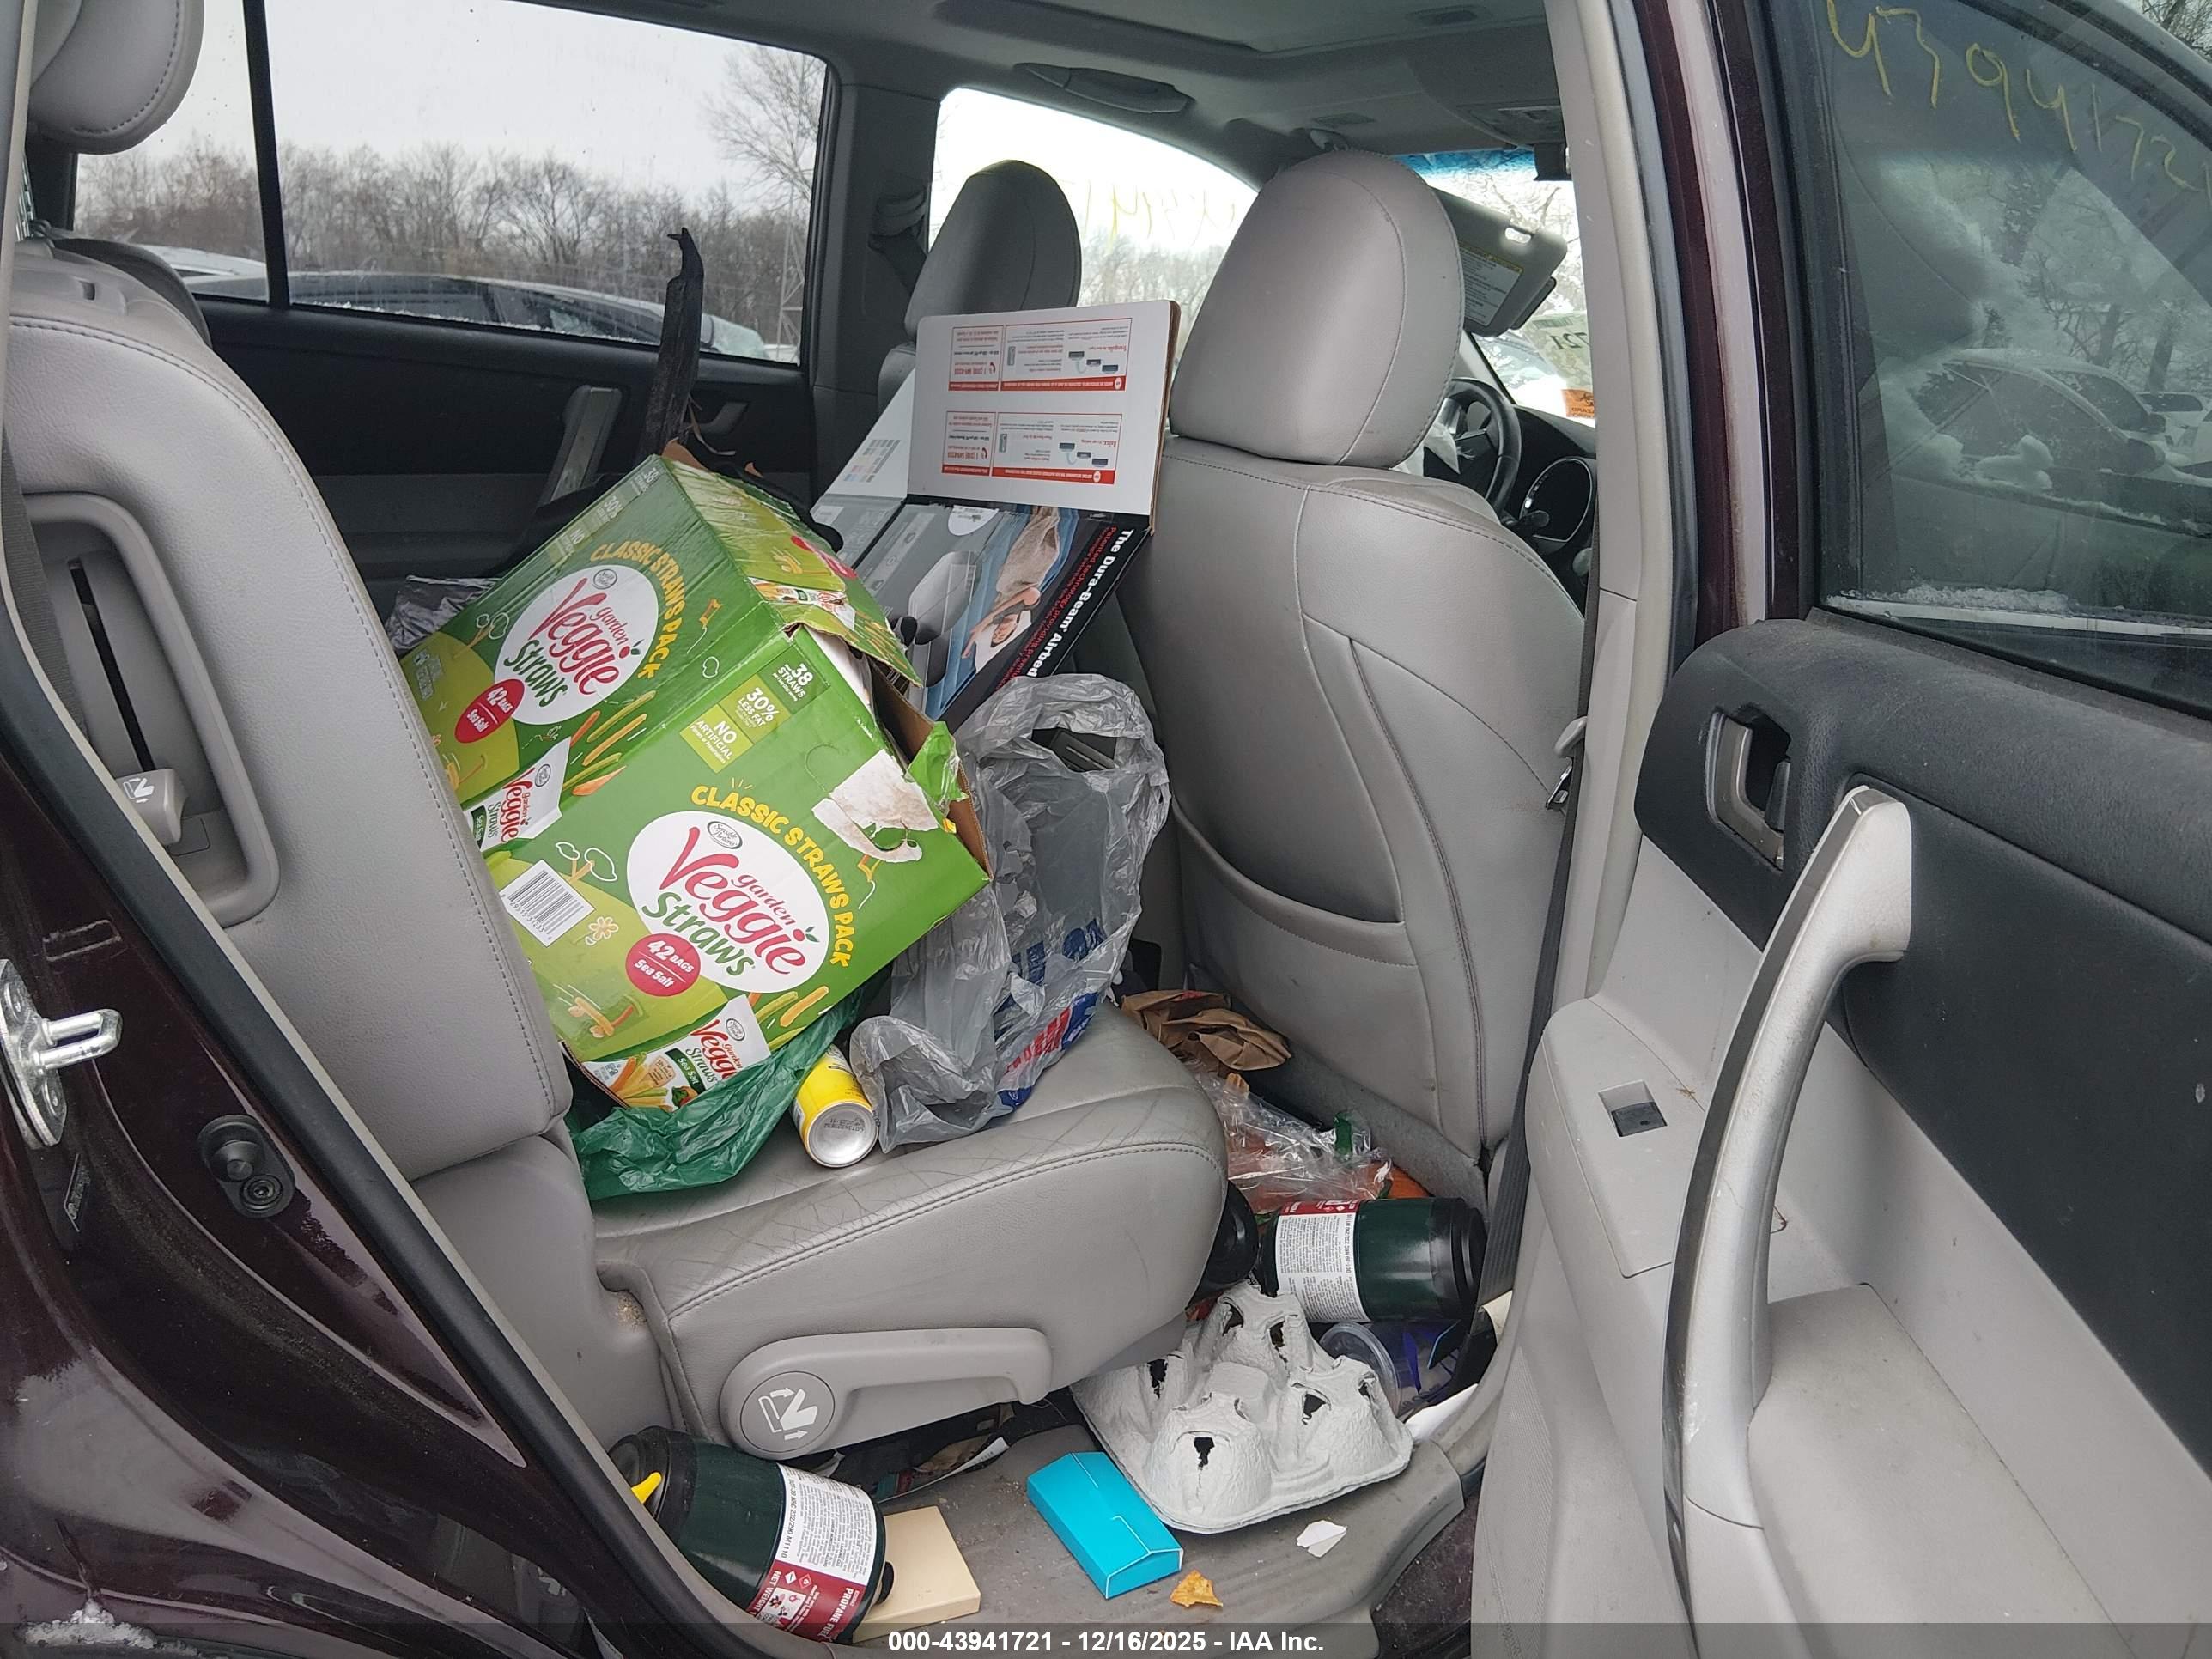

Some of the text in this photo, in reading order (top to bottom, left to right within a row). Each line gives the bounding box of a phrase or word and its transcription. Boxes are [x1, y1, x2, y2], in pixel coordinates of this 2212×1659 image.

[569, 528, 586, 544] NO
[590, 540, 661, 567] CLASSIC
[1090, 526, 1118, 563] Patented
[1109, 528, 1135, 553] The
[649, 551, 687, 621] STRAWS
[1060, 564, 1092, 609] technology
[528, 577, 620, 696] Veggie
[590, 606, 630, 646] garden
[1030, 609, 1061, 648] providing
[637, 617, 684, 680] PACK
[1026, 632, 1063, 678] Airbed
[504, 639, 568, 708] Straws
[777, 666, 807, 699] STRAWS
[791, 663, 814, 686] 38
[487, 686, 508, 706] 42
[738, 697, 756, 716] LESS
[751, 713, 767, 728] FAT
[746, 687, 780, 723] 30%
[466, 708, 490, 733] Sea Salt
[713, 720, 738, 744] NO
[696, 720, 733, 760] ARTIFICIAL
[487, 801, 502, 839] Straws
[499, 767, 536, 842] Veggie
[690, 785, 854, 968] CLASSIC STRAWS PACK
[659, 826, 806, 975] Veggie
[730, 873, 796, 926] garden
[641, 891, 756, 976] Straws
[634, 958, 675, 988] Sea Salt
[647, 940, 695, 974] 42 BAGS
[677, 1056, 698, 1085] Sea Salt
[685, 1047, 719, 1083] Straws
[721, 1042, 744, 1069] garden
[789, 1497, 798, 1509] NRC
[787, 1510, 797, 1535] 232/290
[781, 1535, 793, 1559] M1110
[769, 1570, 782, 1589] NET
[754, 1587, 775, 1612] WEIGHT
[817, 1587, 854, 1638] PROPANE FUEL
